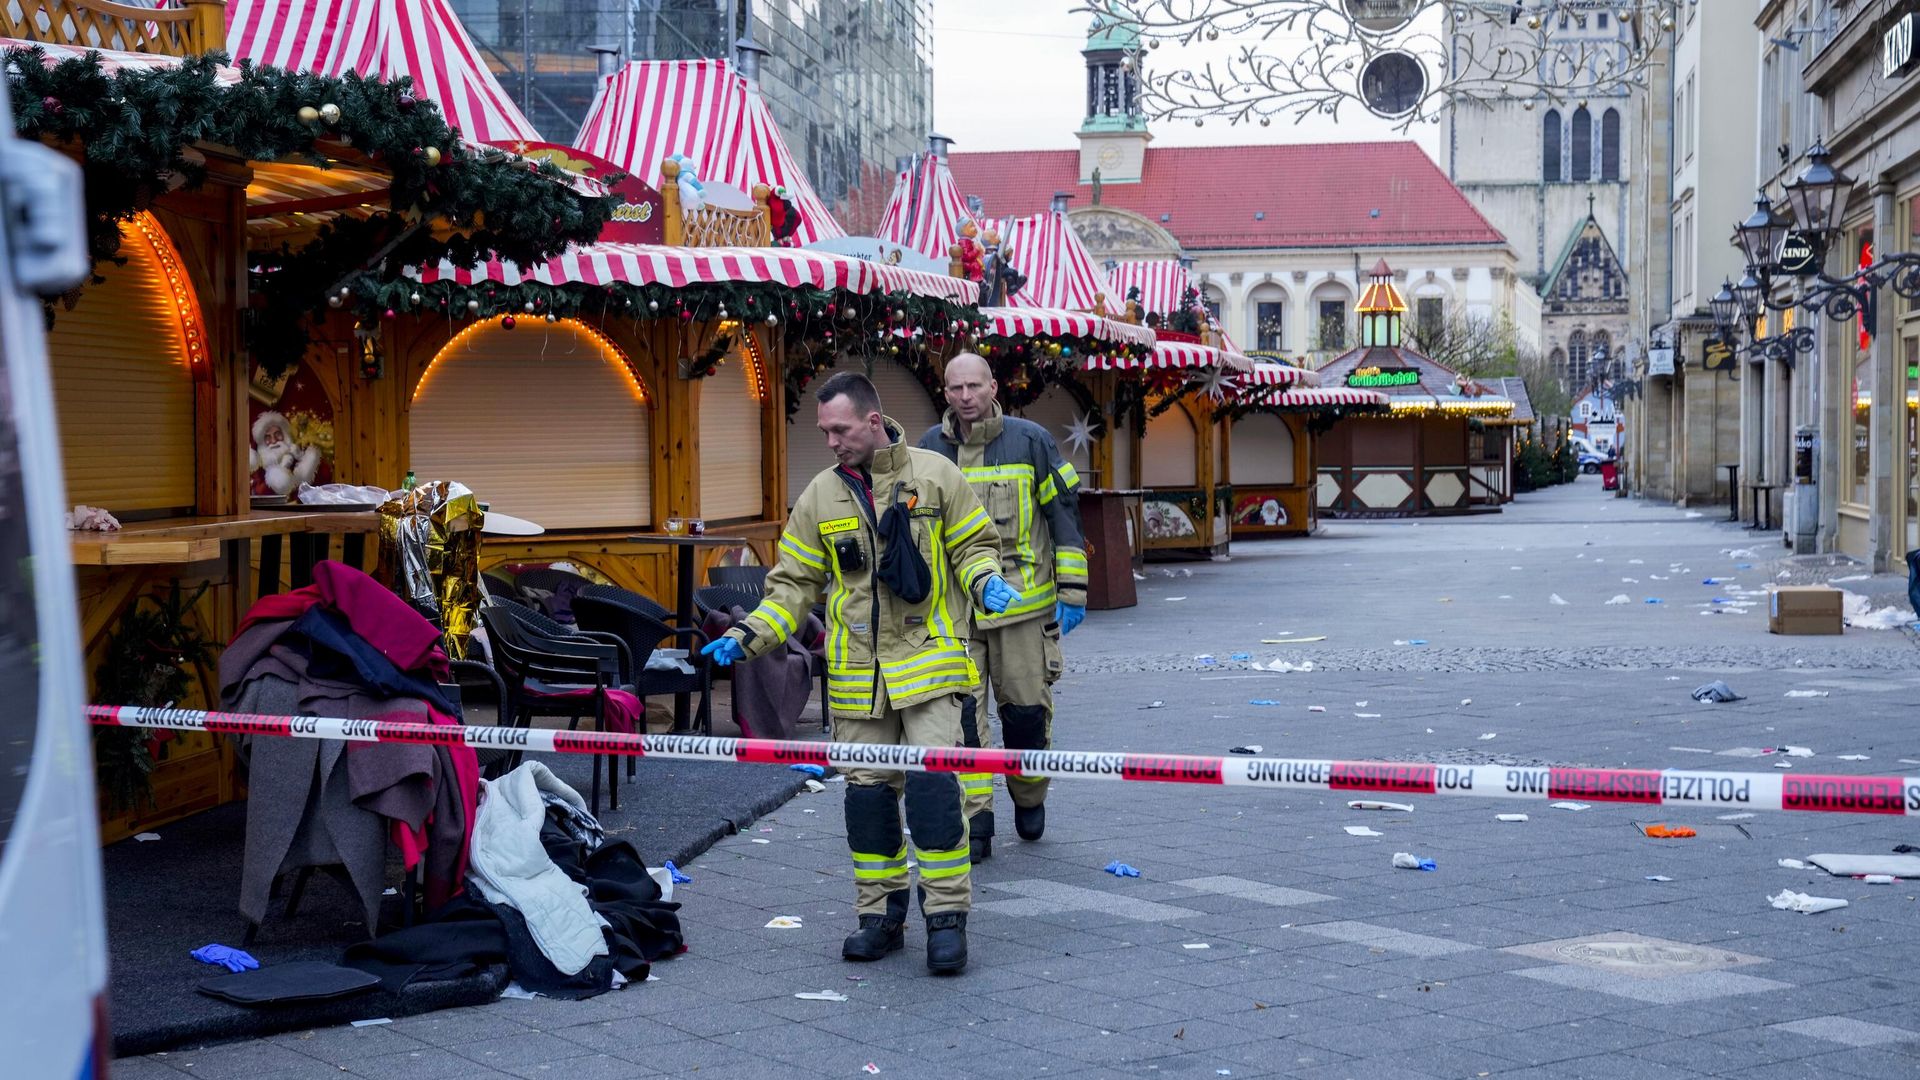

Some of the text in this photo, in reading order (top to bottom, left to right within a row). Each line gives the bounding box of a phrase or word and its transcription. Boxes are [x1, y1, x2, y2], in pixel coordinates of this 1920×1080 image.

[1884, 12, 1913, 79] KIND
[611, 202, 651, 221] urst
[1783, 247, 1810, 258] KIND
[1349, 372, 1417, 386] Grillstübchen
[135, 706, 317, 734] POLIZEIABSPERRUNG
[341, 719, 527, 746] POLIZEIABSPERRUNG
[554, 731, 747, 757] POLIZEIABSPERRUNG
[773, 742, 976, 768] POLIZEIABSPERRUNG
[1003, 751, 1217, 779] POLIZEIABSPERRUNG
[1247, 760, 1473, 789] POLIZEIABSPERRUNG
[1506, 769, 1750, 802] POLIZEIABSPERRUNG
